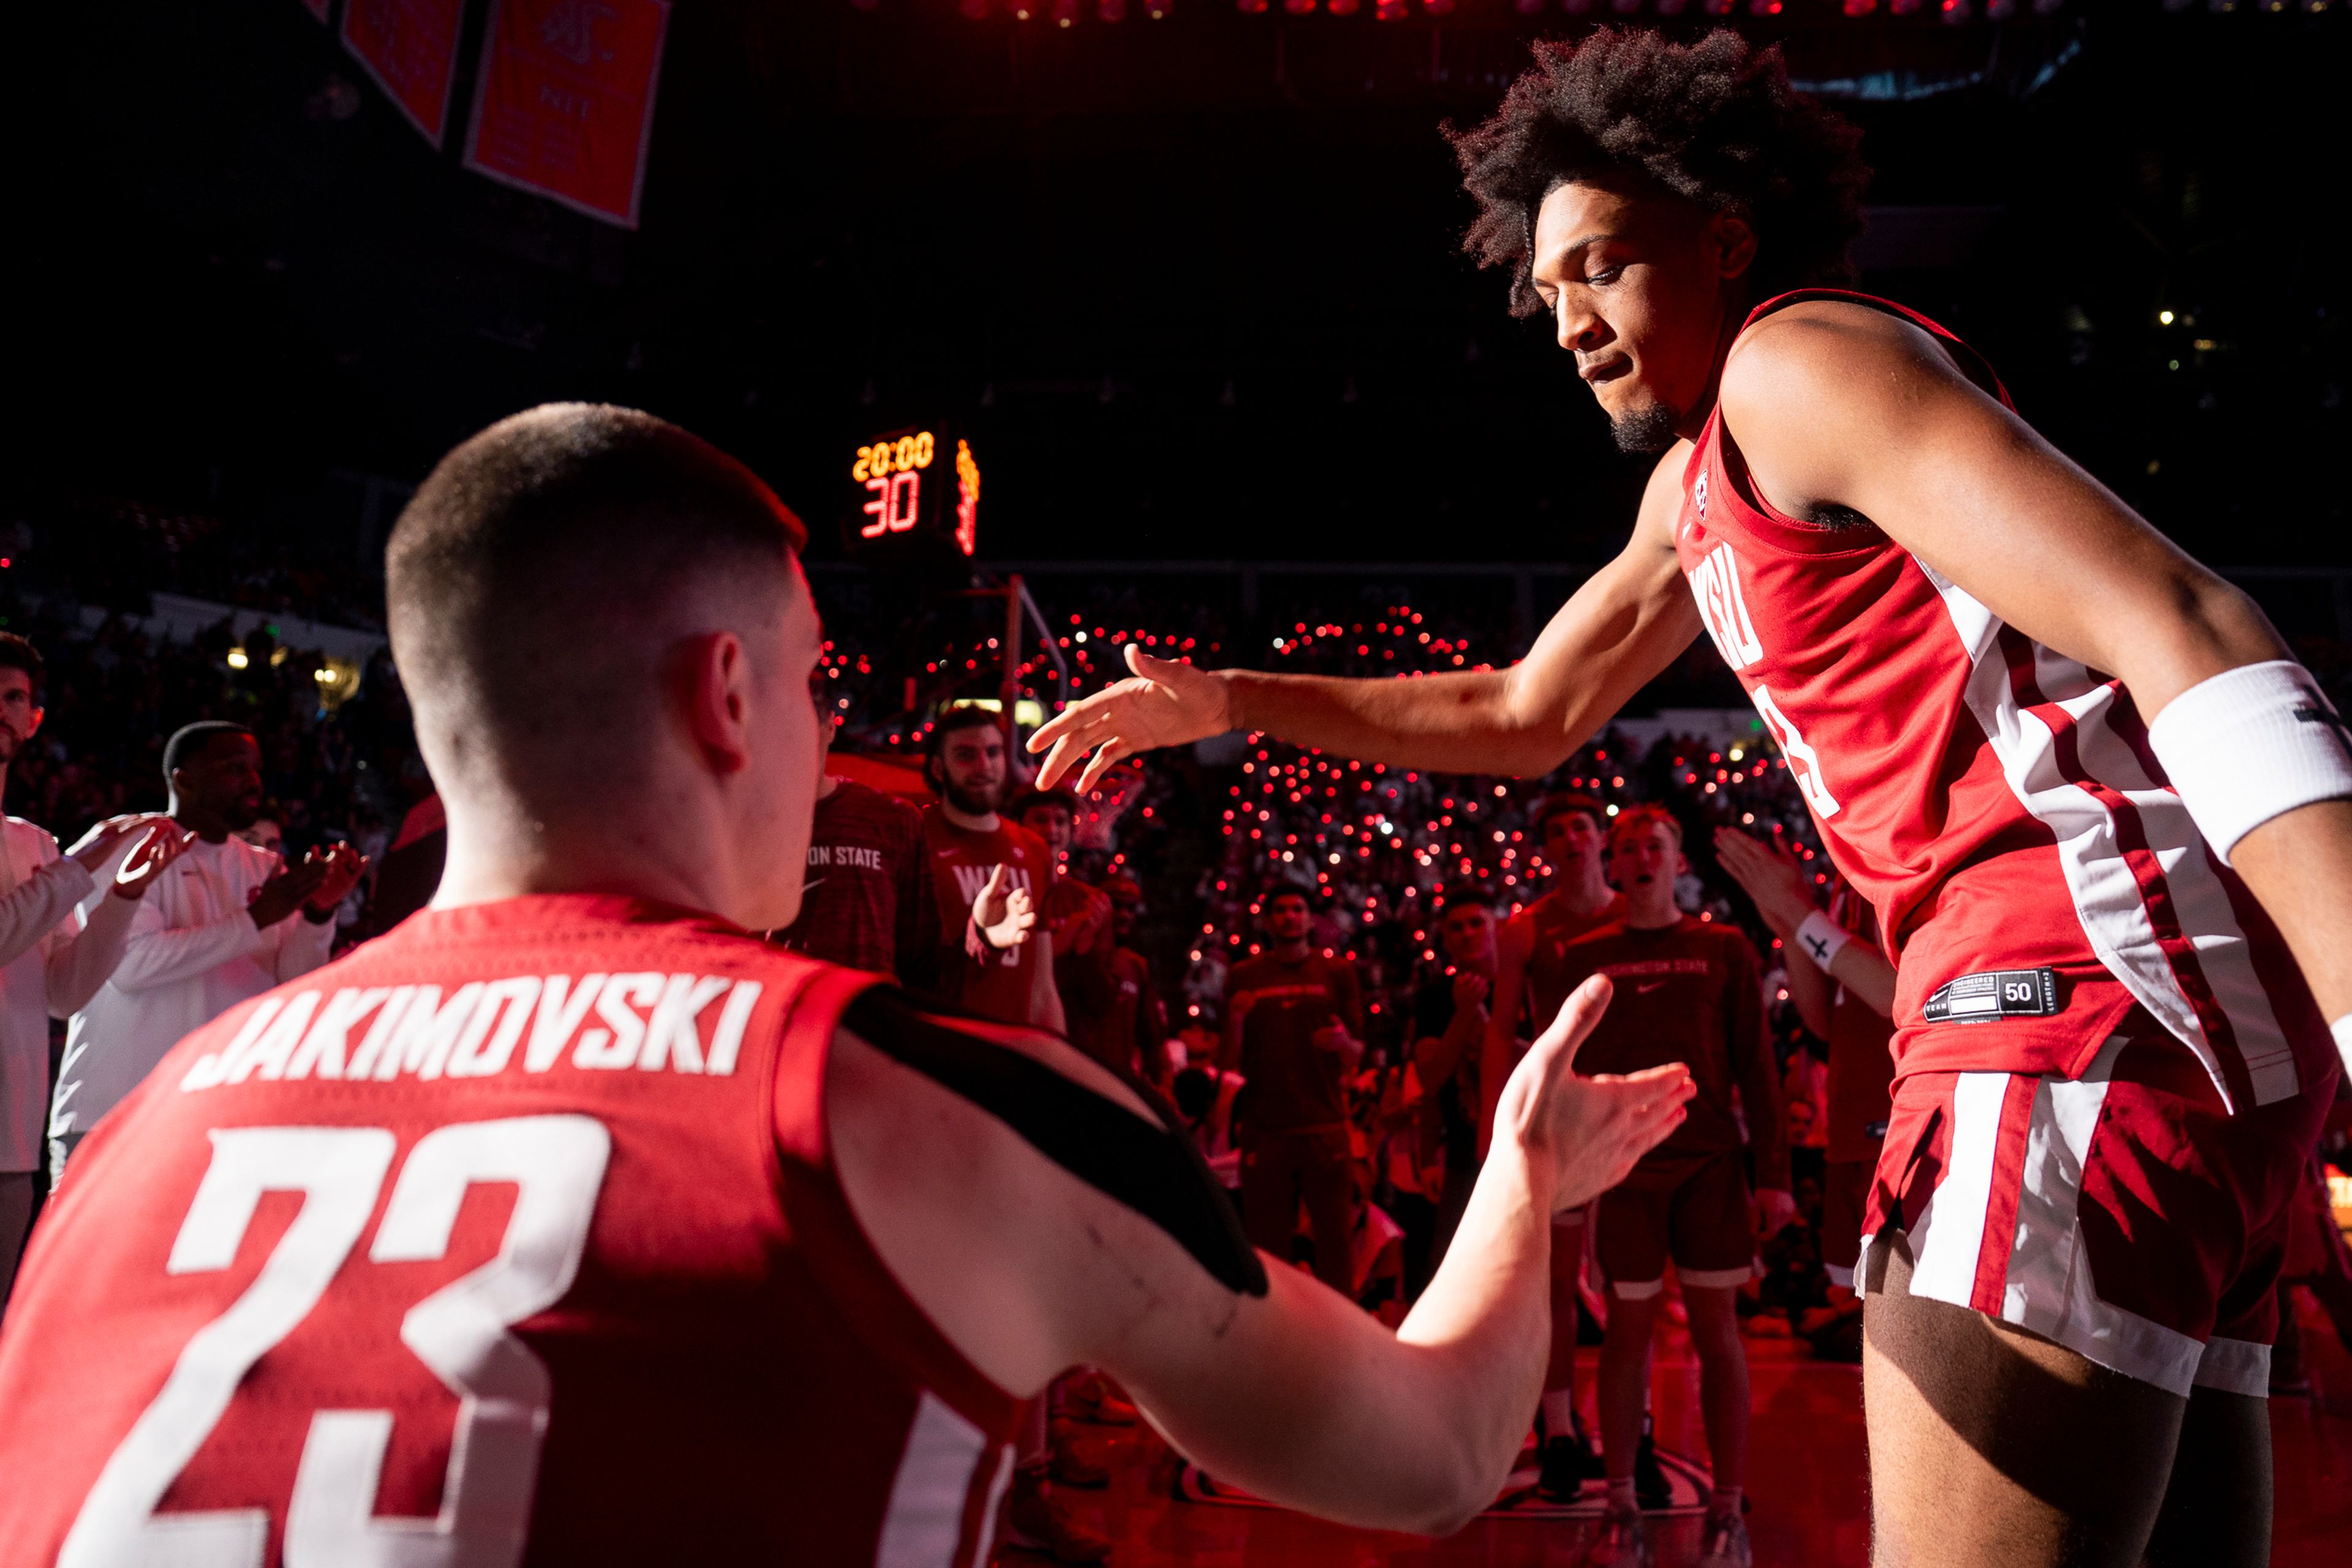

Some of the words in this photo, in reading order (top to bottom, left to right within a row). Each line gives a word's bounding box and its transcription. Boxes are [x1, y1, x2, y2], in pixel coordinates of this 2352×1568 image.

[539, 80, 595, 123] NIT
[853, 431, 934, 482] 20:00
[862, 470, 919, 538] 30
[1688, 541, 1763, 671] WSU
[835, 846, 882, 870] STATE
[1926, 1003, 1947, 1012] TEAM
[2005, 982, 2032, 1002] 50
[182, 971, 763, 1091] JAKIMOVSKI
[55, 1114, 612, 1568] 23
